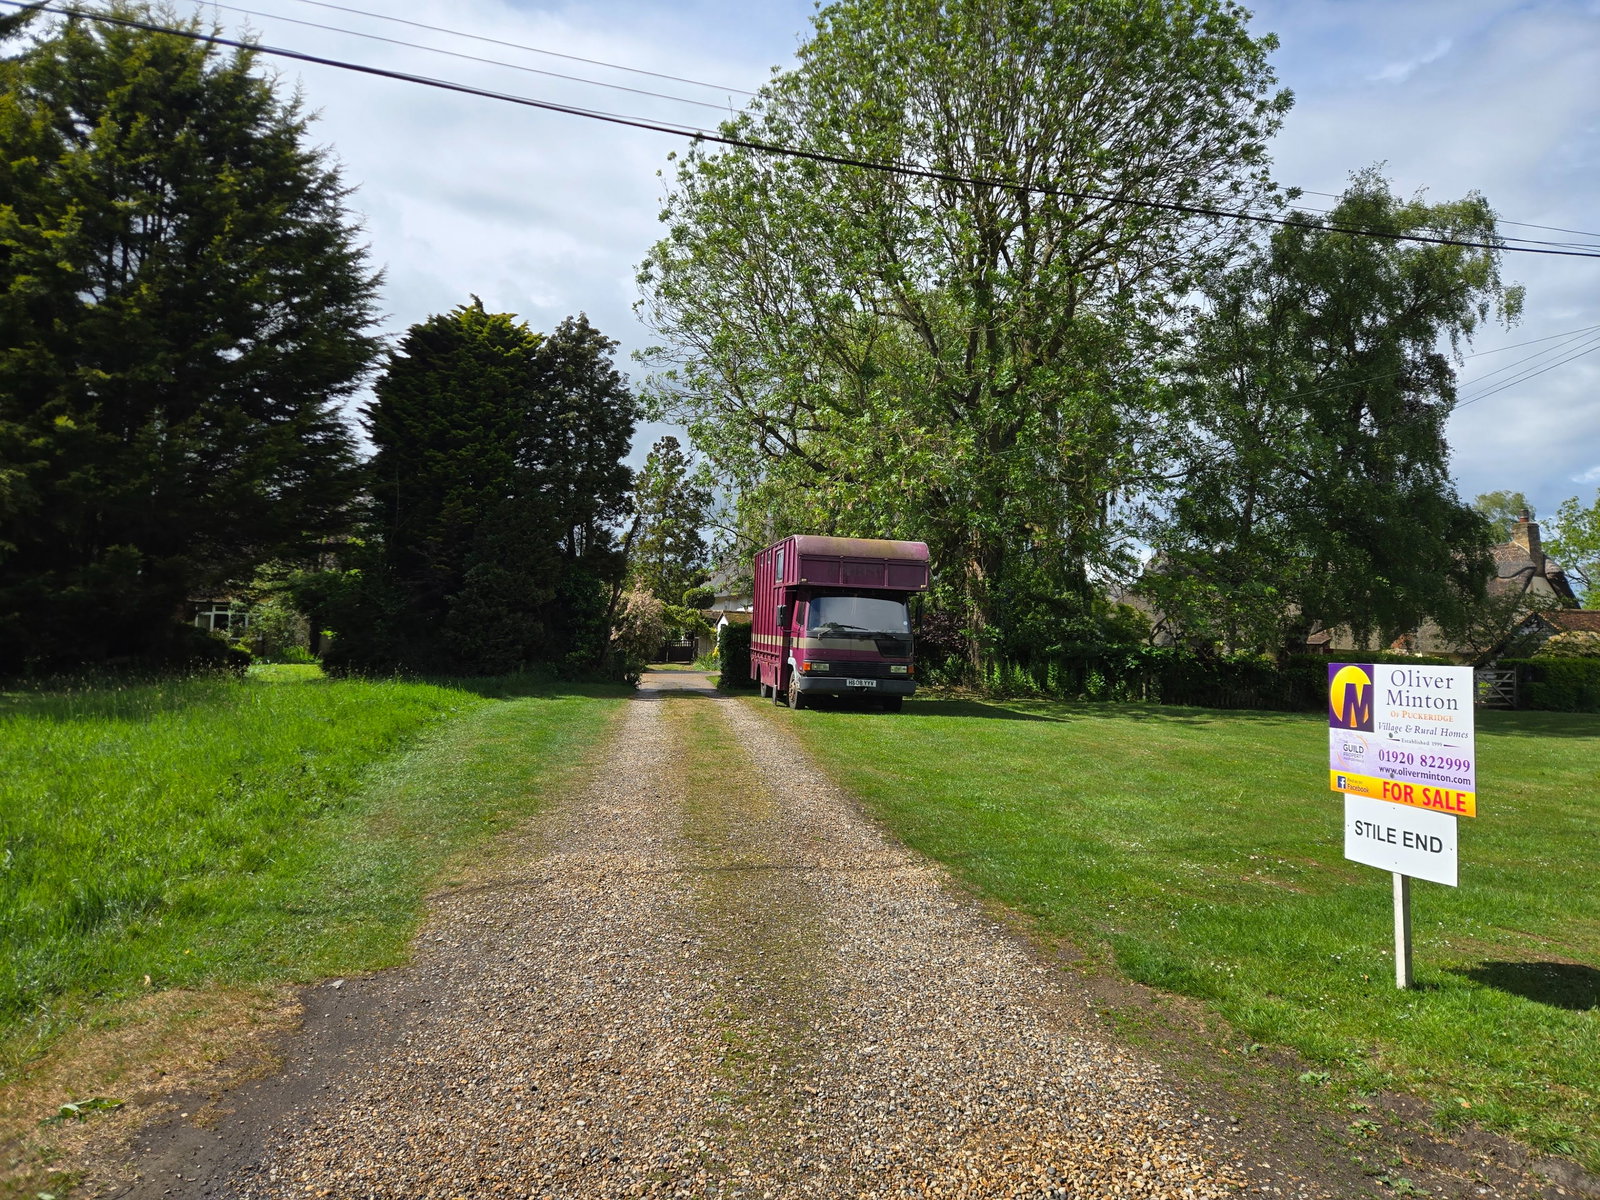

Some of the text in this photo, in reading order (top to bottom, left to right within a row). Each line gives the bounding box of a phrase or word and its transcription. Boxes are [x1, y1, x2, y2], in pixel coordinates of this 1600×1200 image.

[1391, 669, 1454, 689] Oliver
[1386, 689, 1459, 710] Minton
[1402, 710, 1454, 722] PUCKERIDGE
[1378, 721, 1469, 739] Village & Rural Homes
[1343, 744, 1364, 753] GUILD
[1401, 737, 1430, 746] Established
[1378, 749, 1470, 772] 01920 822999
[1378, 765, 1471, 786] www.oliverminton.com
[1347, 783, 1369, 793] Facebook
[1382, 781, 1467, 812] FOR SALE
[1355, 820, 1442, 853] STILE END
